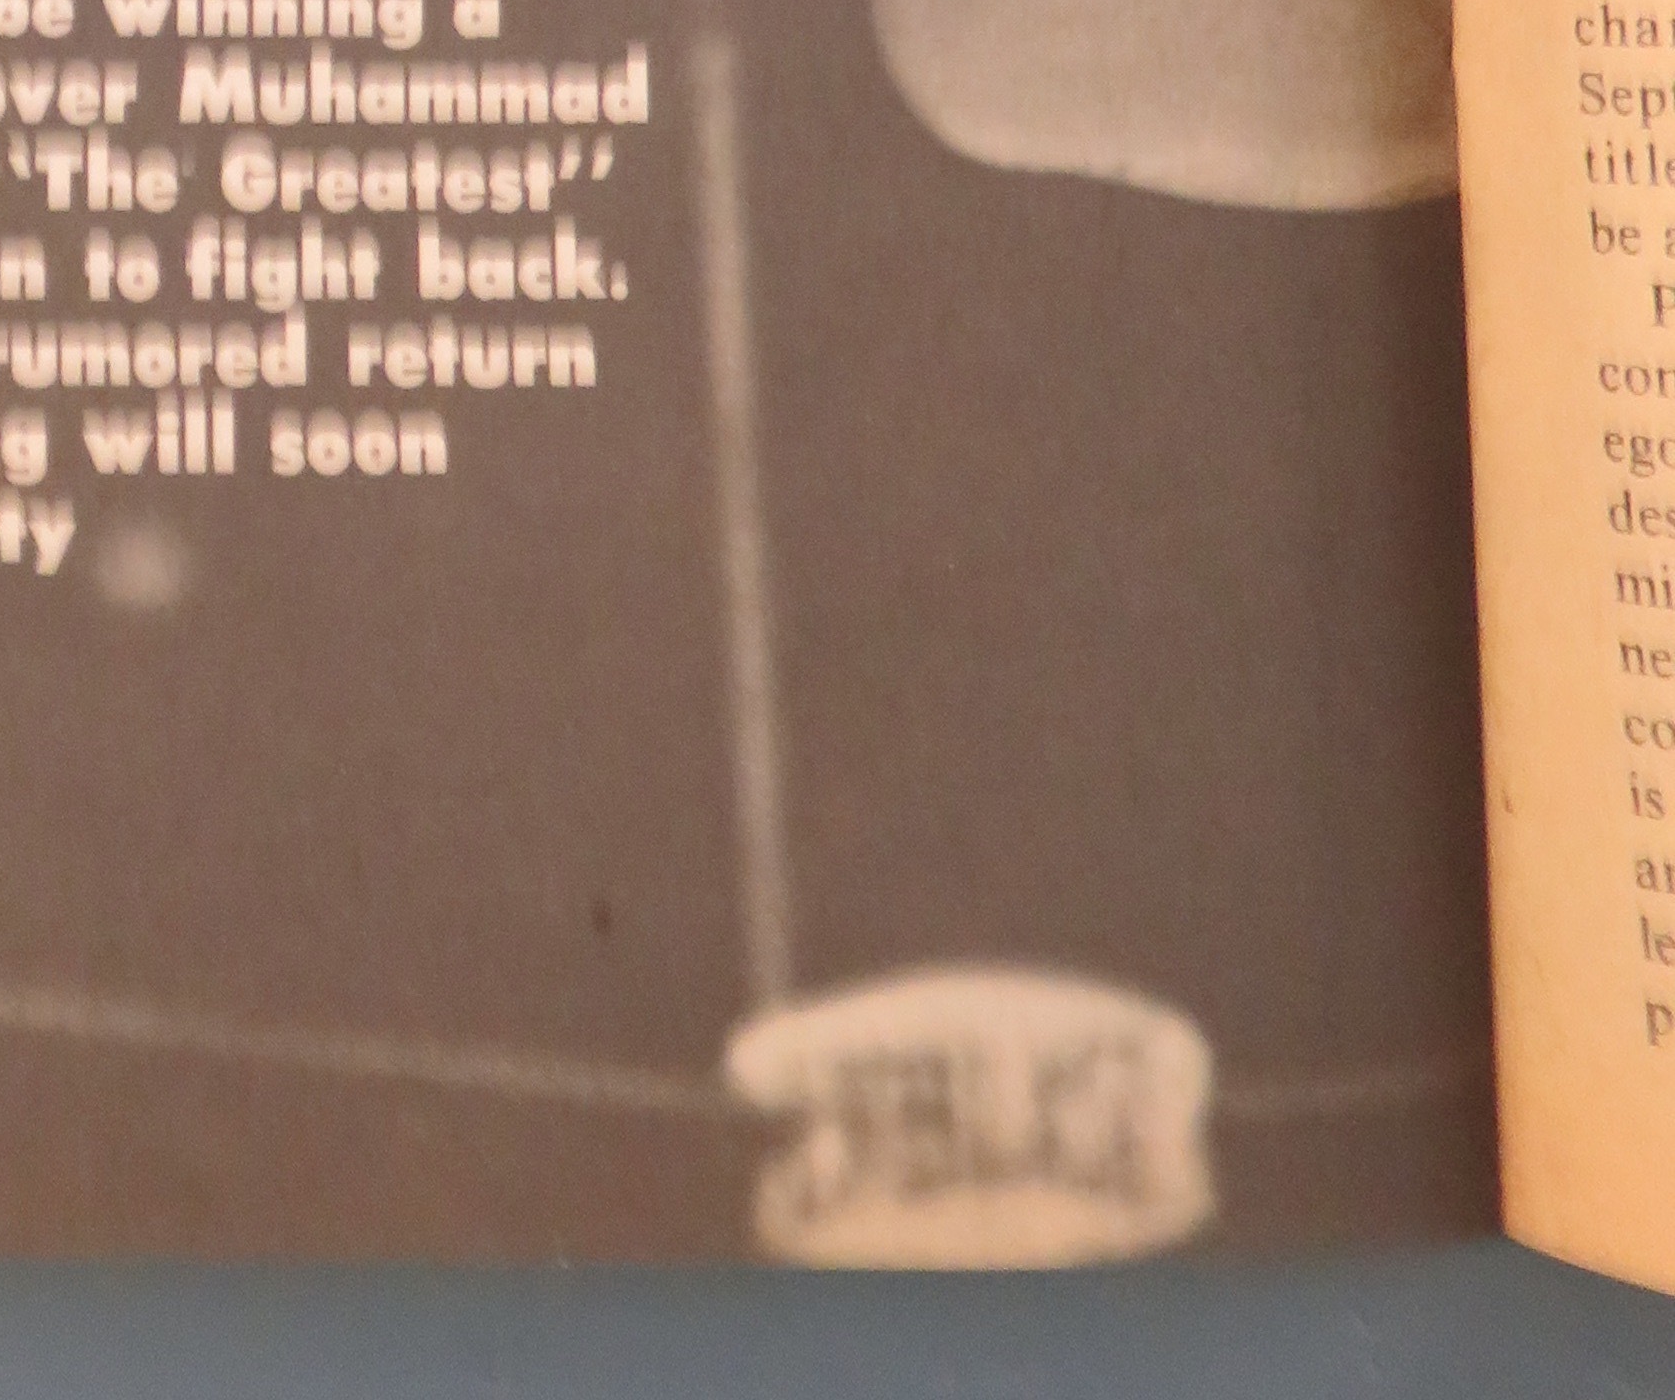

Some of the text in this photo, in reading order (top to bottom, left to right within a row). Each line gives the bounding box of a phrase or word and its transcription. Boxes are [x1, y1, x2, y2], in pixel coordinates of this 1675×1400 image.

[180, 40, 650, 124] Muhammad
[86, 225, 160, 300] to
[186, 213, 380, 312] fight
[419, 213, 628, 300] back.
[1590, 206, 1641, 256] be
[348, 312, 597, 388] return
[83, 386, 235, 475] will
[270, 404, 448, 475] soon
[1629, 769, 1667, 821] is
